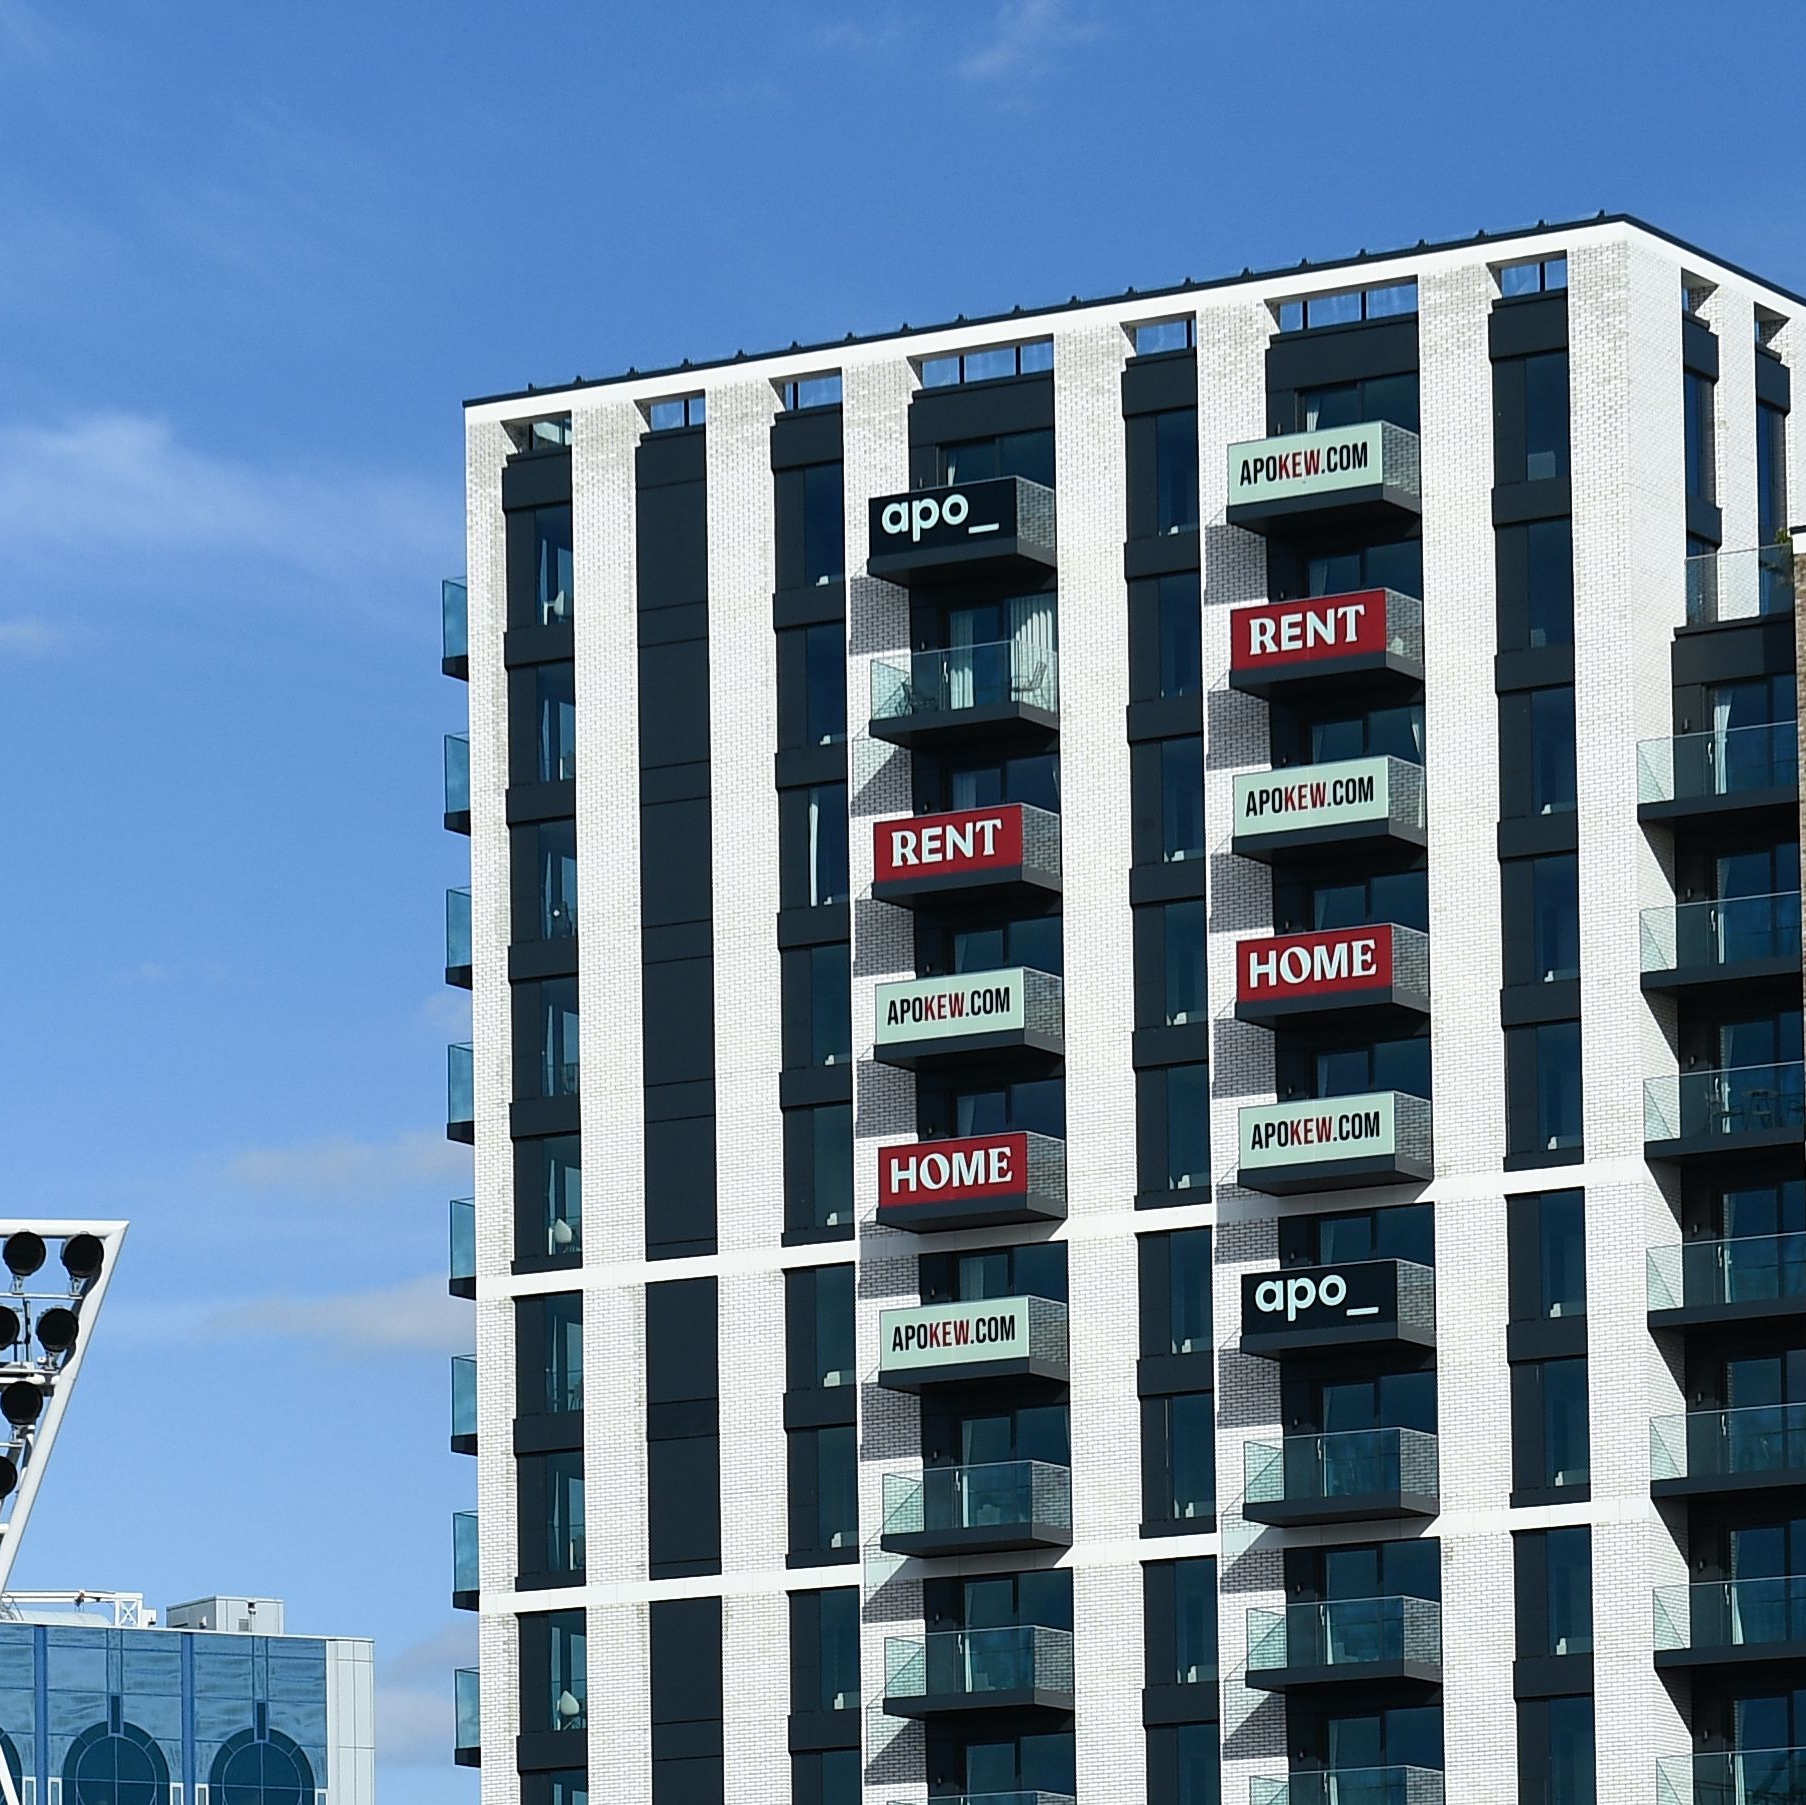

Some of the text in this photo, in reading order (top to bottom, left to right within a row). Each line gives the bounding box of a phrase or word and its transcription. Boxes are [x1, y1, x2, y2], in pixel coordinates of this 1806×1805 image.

[1239, 442, 1368, 487] APOKEW.COM
[1248, 604, 1366, 655] RENT
[1245, 776, 1374, 818] APOKEW.COM
[891, 817, 1003, 868] RENT
[1249, 938, 1377, 988] HOME
[887, 986, 1011, 1026] APOKEW.COM
[1250, 1110, 1380, 1151] APOKEW.COM
[890, 1146, 1013, 1194] HOME
[891, 1314, 1016, 1353] APOKEW.COM
